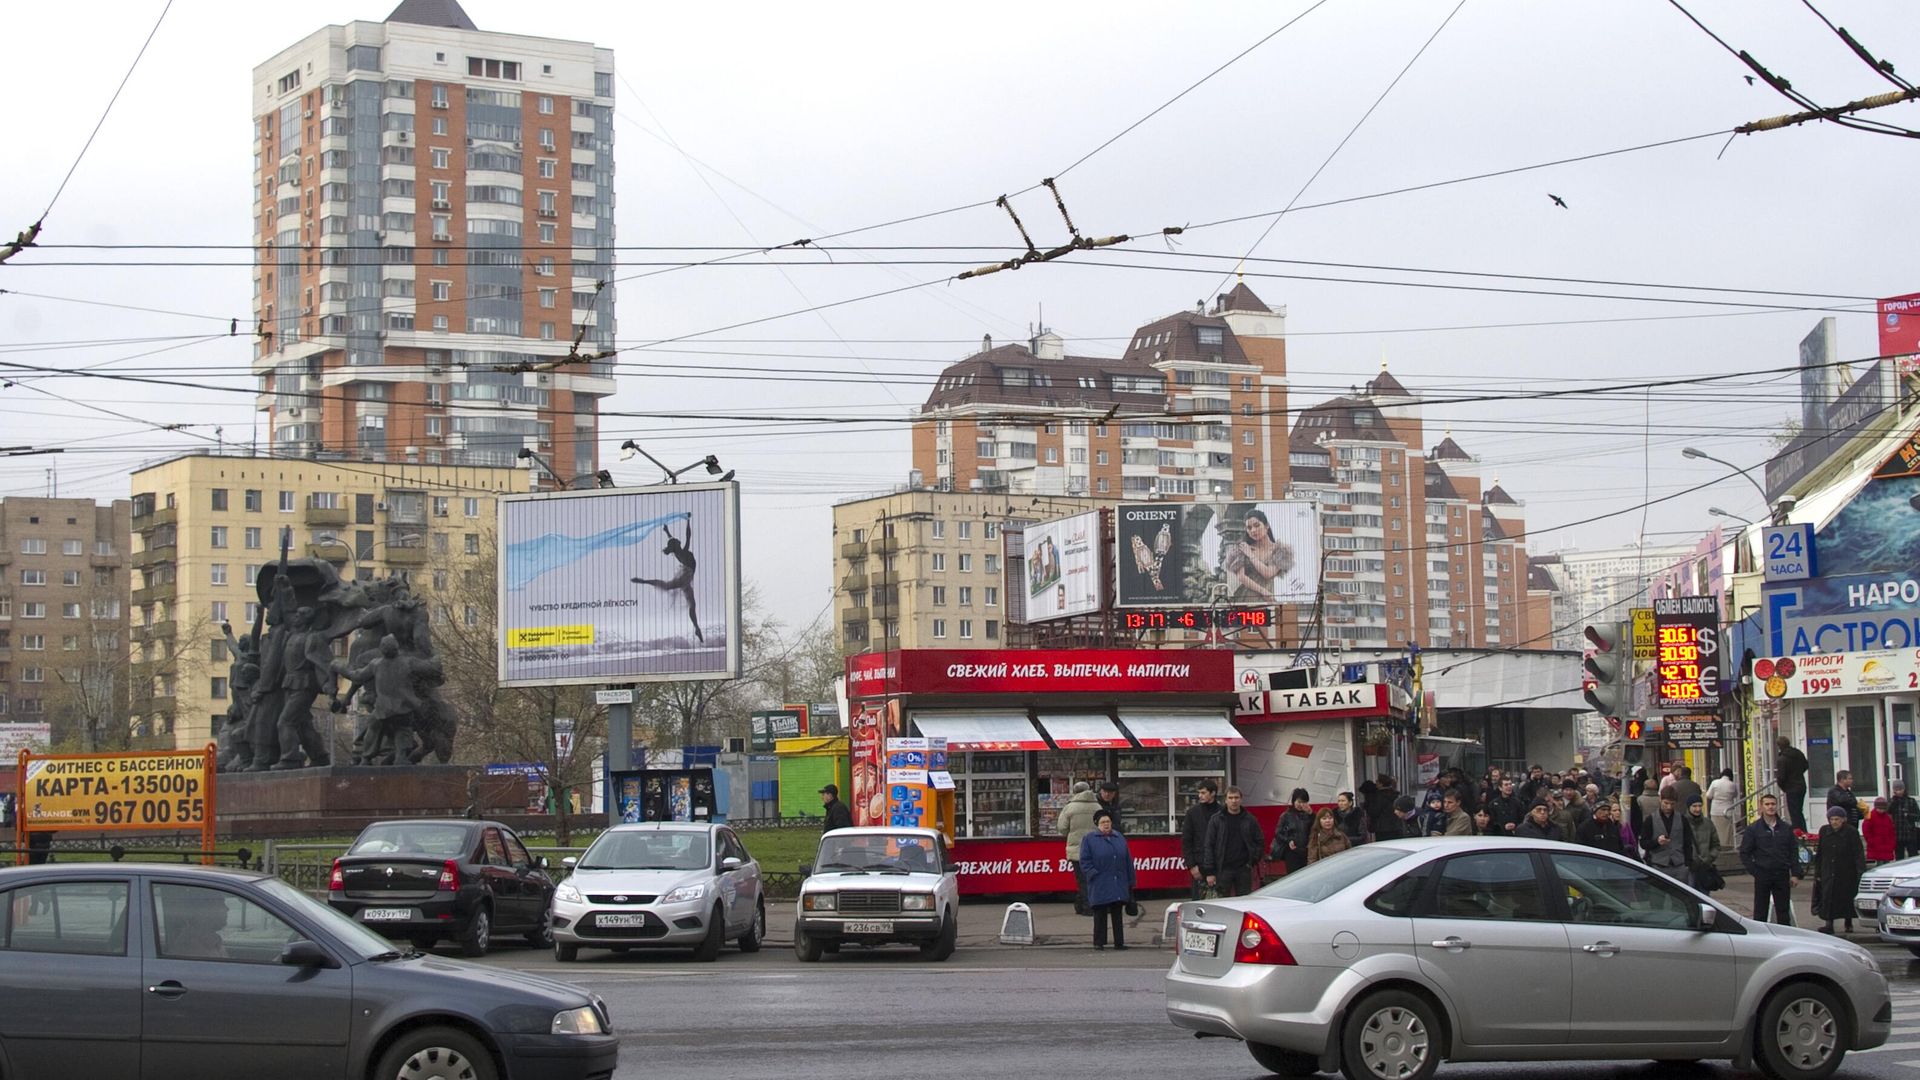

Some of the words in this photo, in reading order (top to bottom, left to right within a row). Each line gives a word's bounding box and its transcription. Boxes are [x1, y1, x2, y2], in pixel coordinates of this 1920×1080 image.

[1126, 510, 1176, 521] ORIENT
[1768, 532, 1802, 560] 24
[1770, 563, 1803, 575] ЧАСА
[529, 603, 560, 612] ЧУВСТВО
[560, 599, 602, 610] КРЕДИТНОЙ
[1655, 599, 1681, 615] ОБМЕН
[1682, 598, 1715, 614] ВАЛЮТЫ
[1659, 628, 1696, 643] 30.61
[1660, 646, 1697, 661] 30.90
[1799, 655, 1844, 667] ПИРОГИ
[947, 662, 1007, 678] СВЕЖИЙ
[1127, 663, 1190, 678] НАПИТКИ
[1660, 664, 1698, 680] 42.70
[1661, 683, 1699, 698] 43.05
[1283, 689, 1362, 708] ТАБАК
[1660, 697, 1720, 705] КРУГЛОСУТОЧНО
[46, 761, 103, 774] ФИТНЕС
[106, 760, 116, 772] С
[119, 755, 204, 772] БАССЕЙНОМ
[120, 774, 199, 797] 13500р
[94, 800, 137, 825] 967
[142, 798, 171, 823] 00
[176, 798, 204, 822] 55
[1133, 856, 1189, 871] НАПИТК
